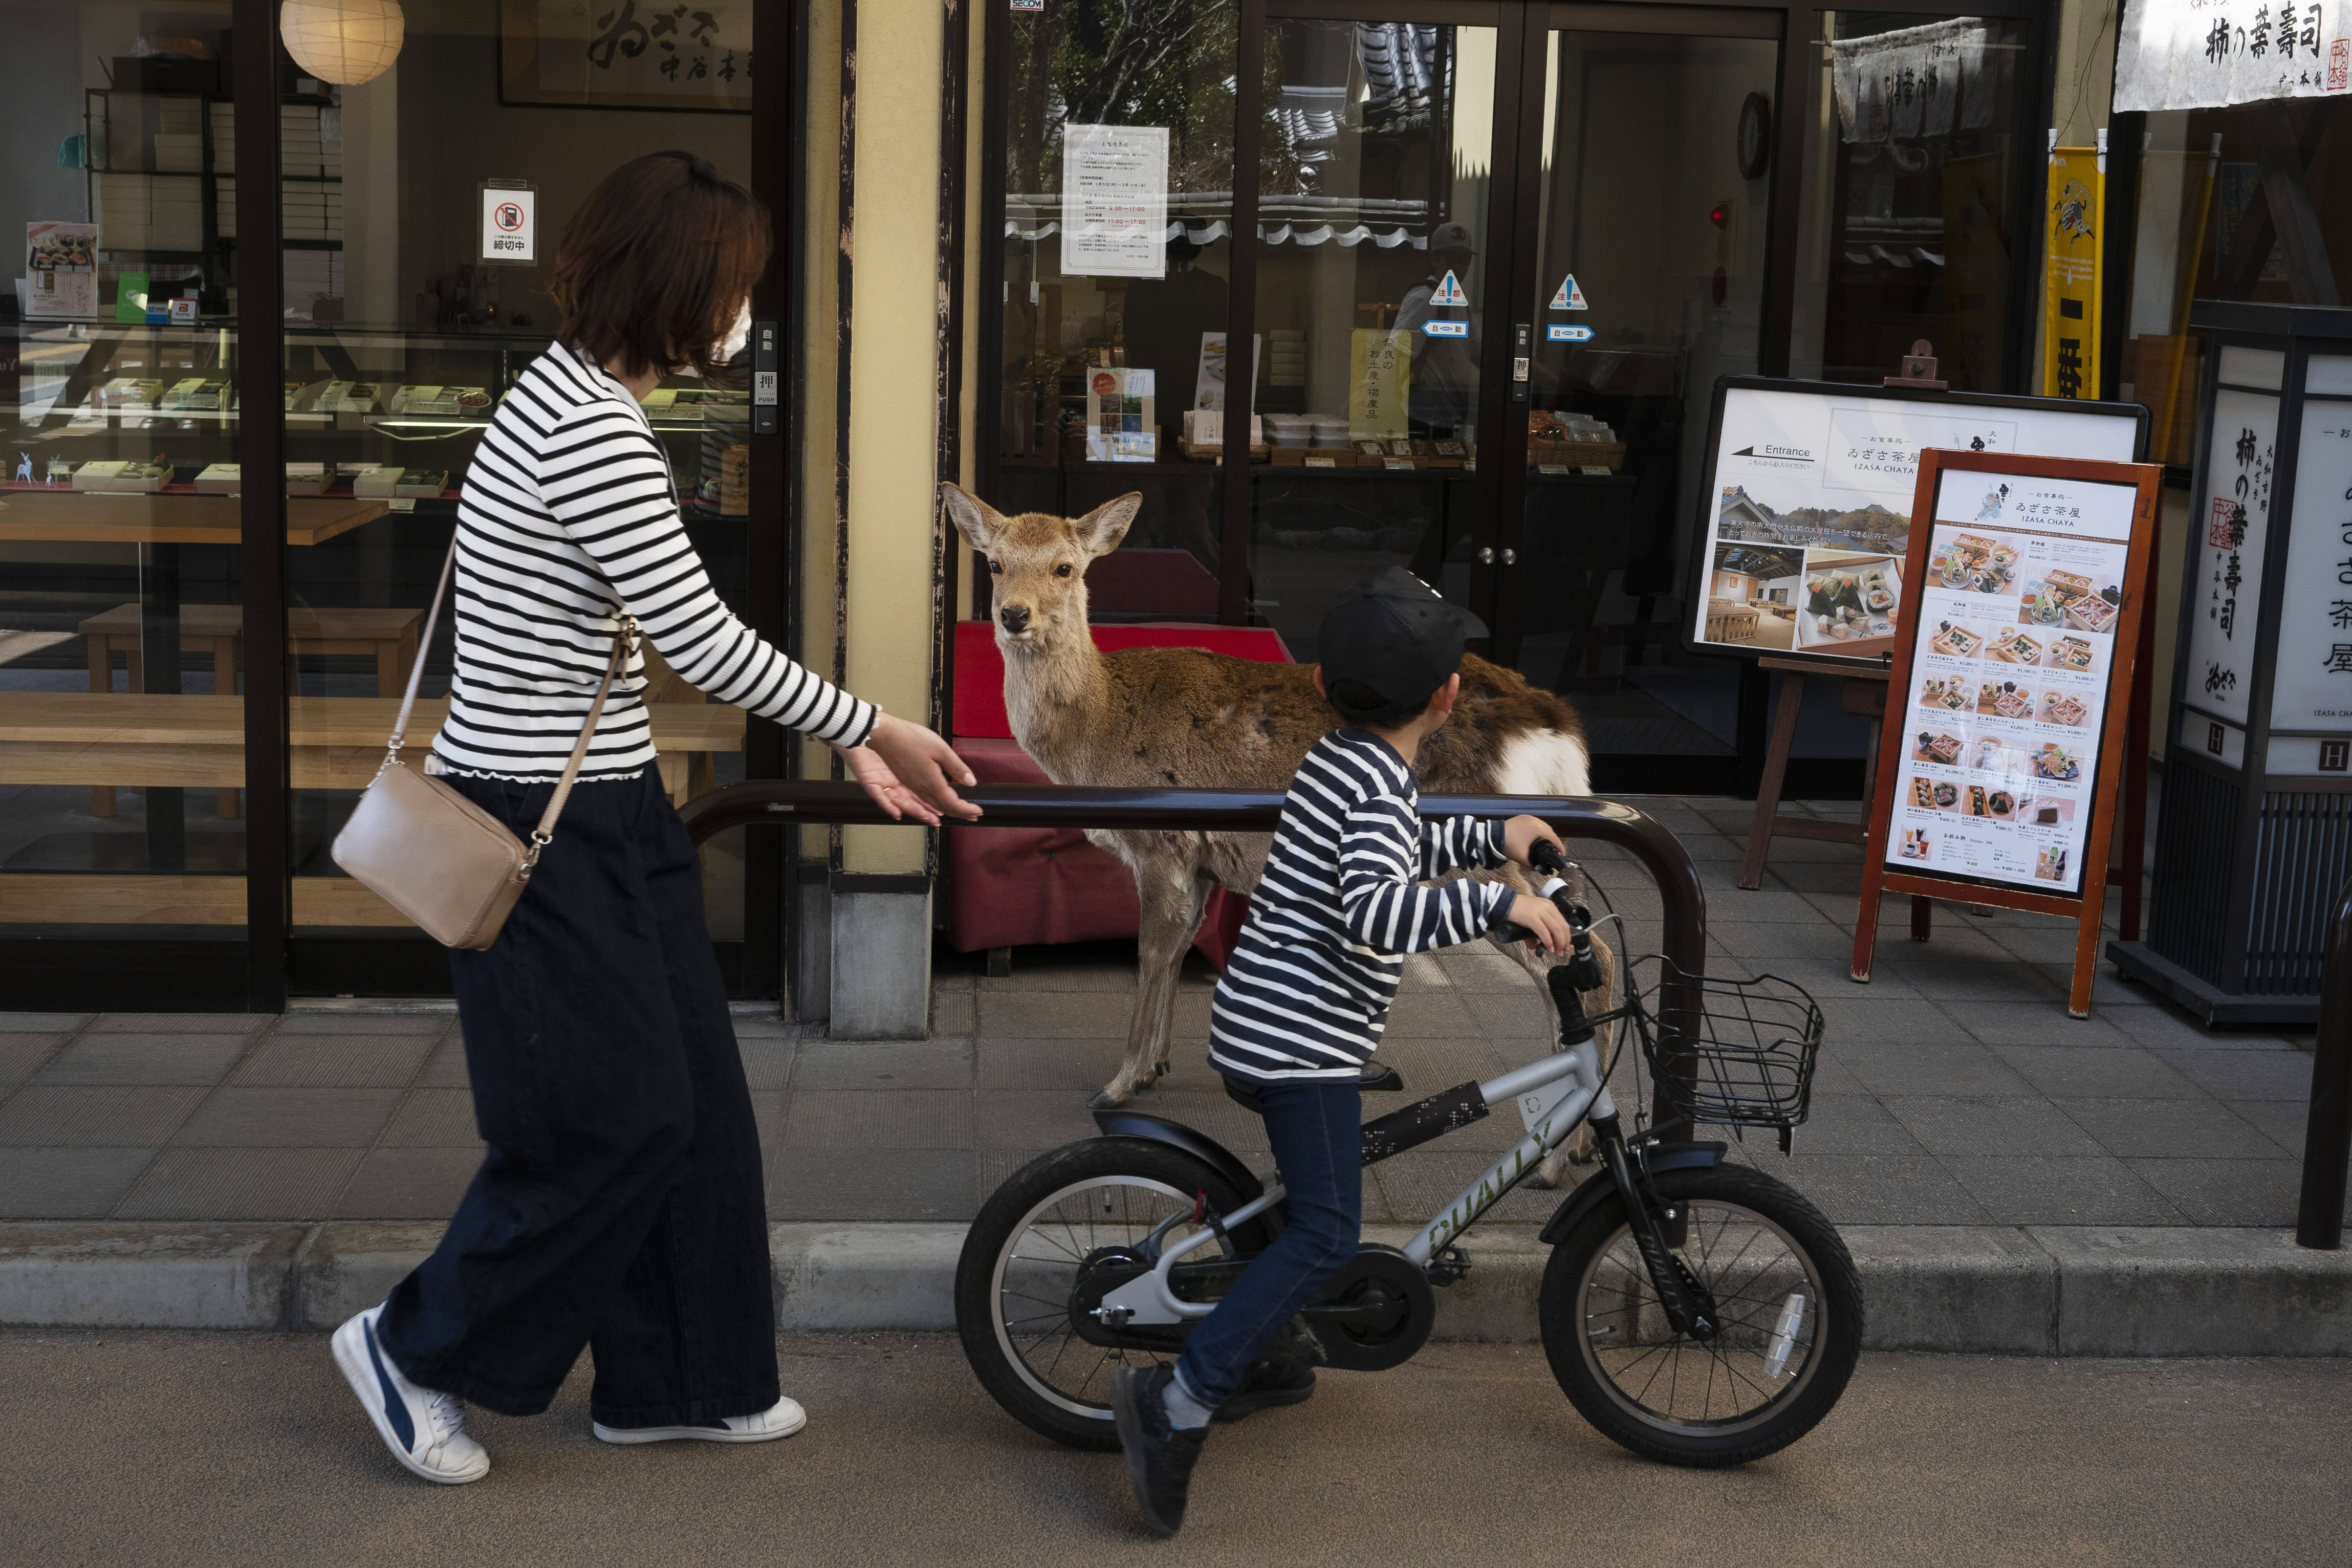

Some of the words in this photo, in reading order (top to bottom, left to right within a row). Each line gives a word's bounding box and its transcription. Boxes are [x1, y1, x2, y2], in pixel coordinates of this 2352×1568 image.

[494, 240, 525, 251] 締切中
[763, 329, 772, 351] 自動
[1382, 338, 1395, 369] 奈良の
[759, 375, 773, 389] 押
[1366, 350, 1380, 419] お土産・物産品
[1869, 436, 1903, 445] お食事処
[1765, 444, 1811, 457] Entrance
[1847, 448, 1921, 465] ゐざさ茶屋
[1748, 459, 1810, 470] こちらからお入りください
[1854, 463, 1880, 472] IZASA
[1884, 465, 1914, 474] CHAYA
[2259, 445, 2273, 513] 大和吉野
[2037, 492, 2065, 500] お食事処
[2015, 503, 2081, 518] ゐざさ茶屋
[2021, 516, 2044, 525] IZASA
[2048, 517, 2075, 527] CHAYA
[1943, 833, 1966, 841] お飲み物
